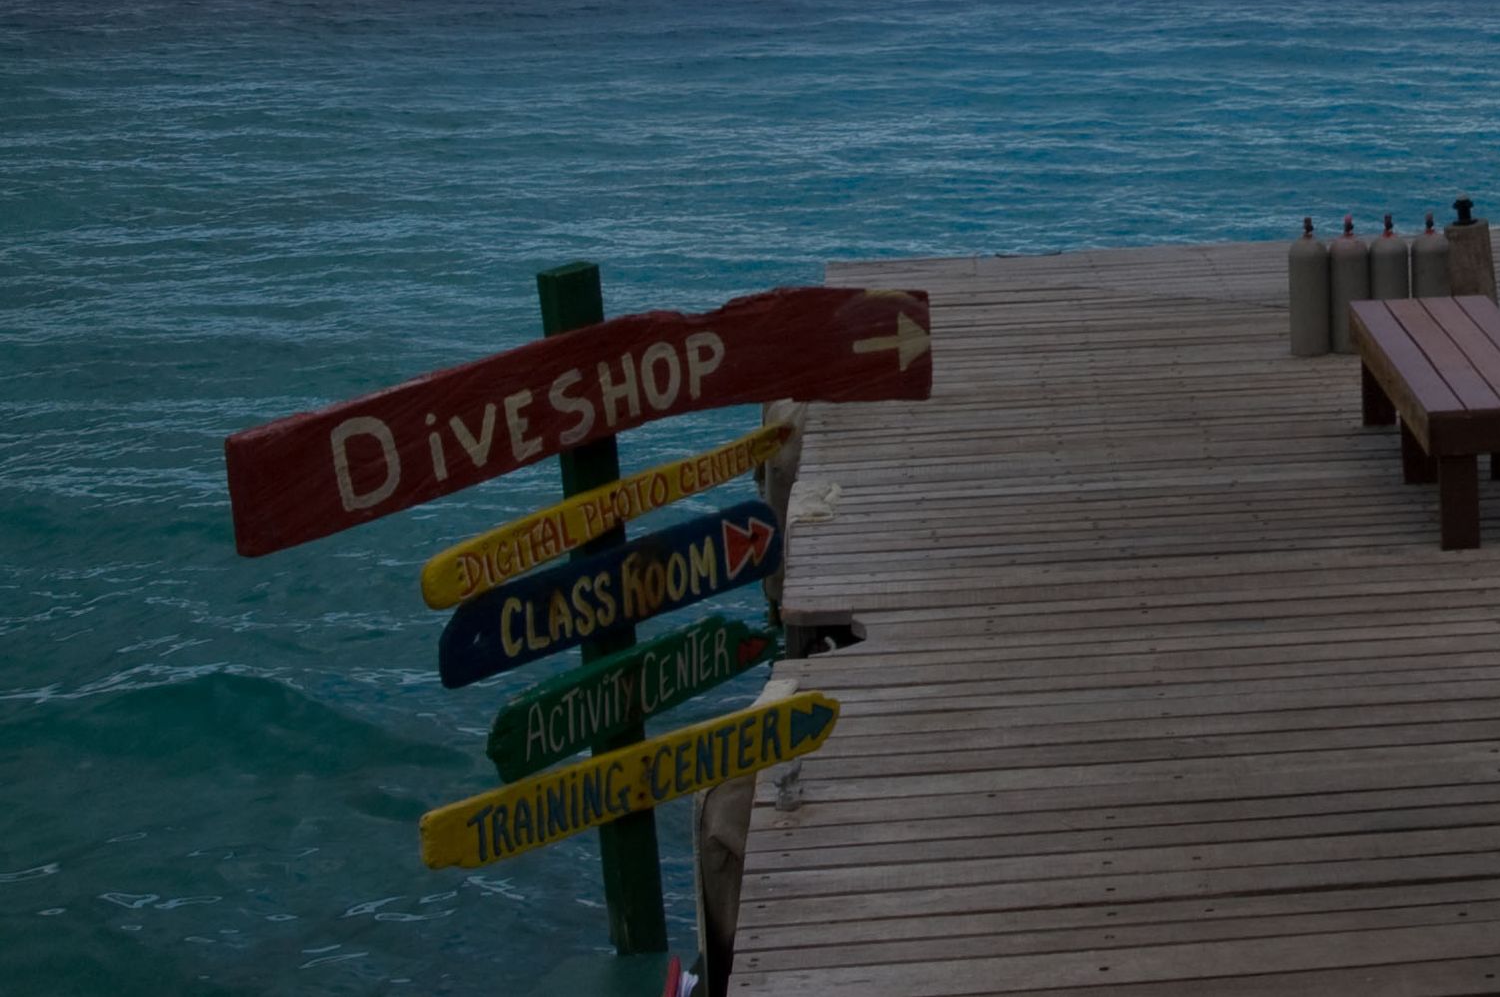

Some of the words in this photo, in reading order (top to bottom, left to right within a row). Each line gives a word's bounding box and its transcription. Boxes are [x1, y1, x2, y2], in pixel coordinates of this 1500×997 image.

[581, 472, 670, 537] PHOTO
[639, 628, 731, 714] CENTER
[649, 708, 783, 801] CENTER
